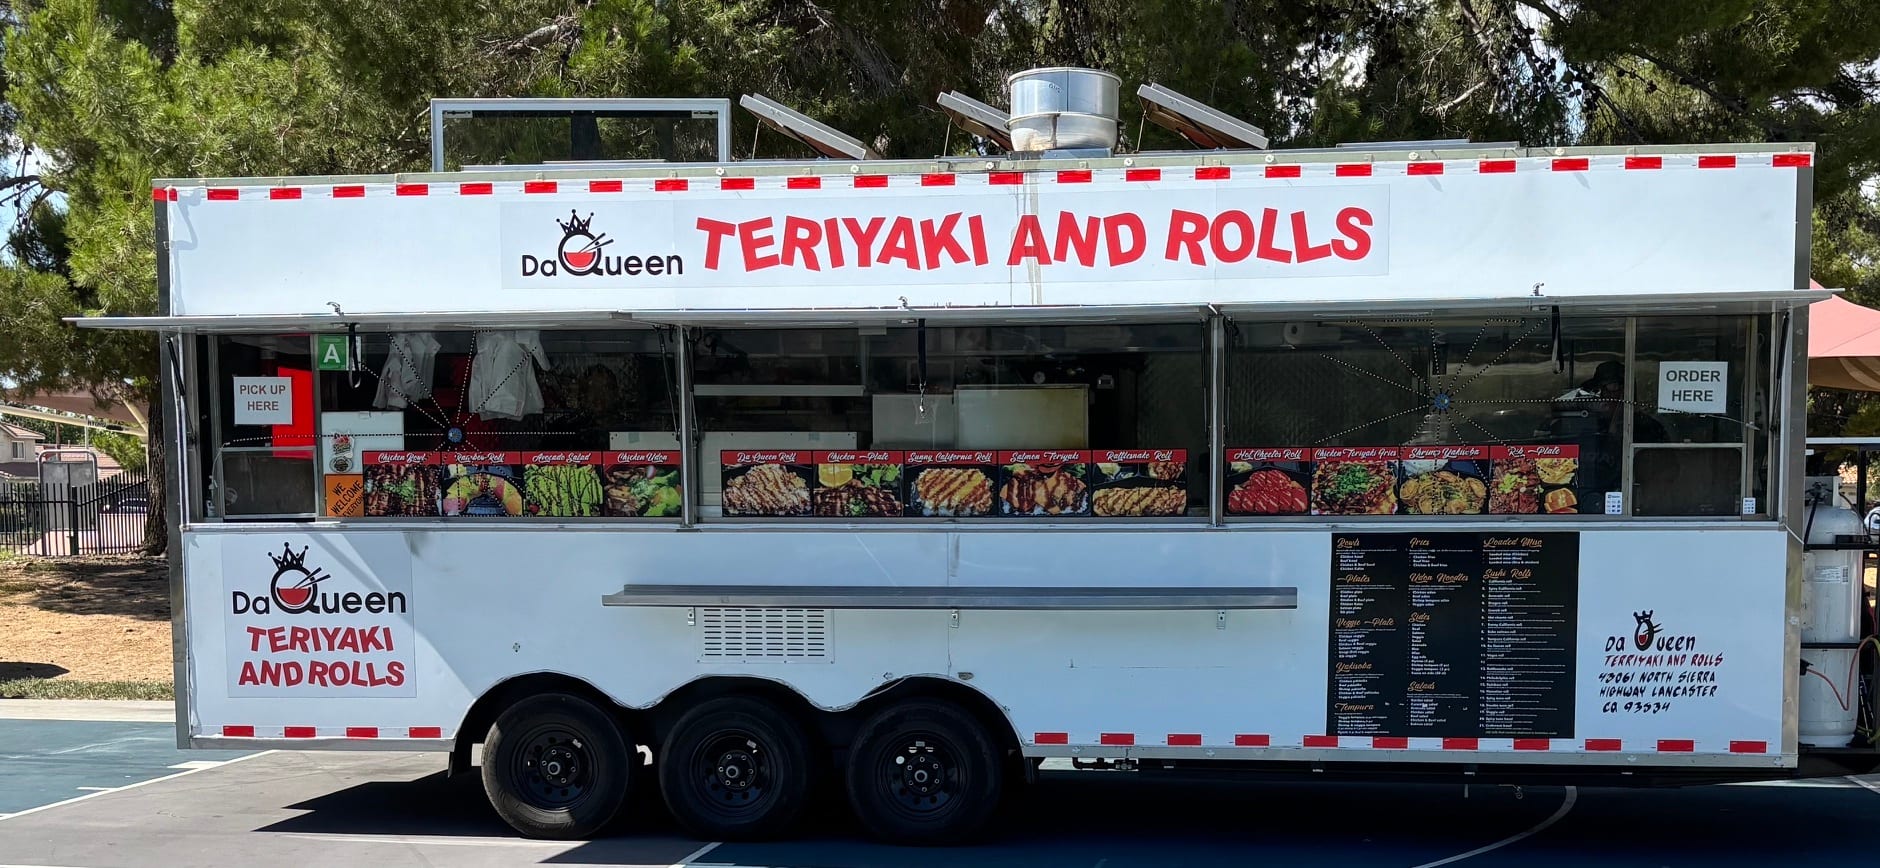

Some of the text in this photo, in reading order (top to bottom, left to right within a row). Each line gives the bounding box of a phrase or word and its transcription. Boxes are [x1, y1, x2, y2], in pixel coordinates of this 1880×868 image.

[522, 207, 1373, 277] Da Queen TERIYAKI AND ROLLS
[323, 343, 341, 364] A
[1666, 370, 1721, 382] ORDER
[240, 385, 286, 395] PICK UP
[1671, 390, 1713, 402] HERE
[247, 401, 279, 411] HERE
[1010, 451, 1080, 462] Salmon Teriyaki
[1106, 451, 1174, 461] Rattlesnake Roll
[1234, 450, 1253, 460] Hot
[1283, 450, 1302, 460] Roll
[1314, 449, 1397, 460] Chicken Teriyaki Fries
[1527, 447, 1560, 455] Plate
[378, 452, 405, 463] Chicken
[532, 452, 591, 463] Avocado Salad
[617, 453, 668, 463] Chicken Udon
[737, 452, 797, 462] Da Queen Roll
[827, 452, 889, 462] Chicken Plate
[908, 452, 992, 463] Sunny California Roll
[332, 482, 346, 496] WE
[331, 480, 363, 514] WELCOME
[232, 567, 406, 614] Da Queen
[247, 626, 394, 653] TERIYAKI
[1605, 636, 1625, 652] Da
[1604, 652, 1723, 668] TERRIYAKI AND ROLLS
[239, 660, 405, 687] AND ROLLS
[1599, 670, 1715, 684] 43061 NORTH SIERRA
[1600, 685, 1718, 698] HIGHWAY LANCASTER
[1335, 703, 1374, 712] Tempura
[1624, 701, 1671, 714] 93534
